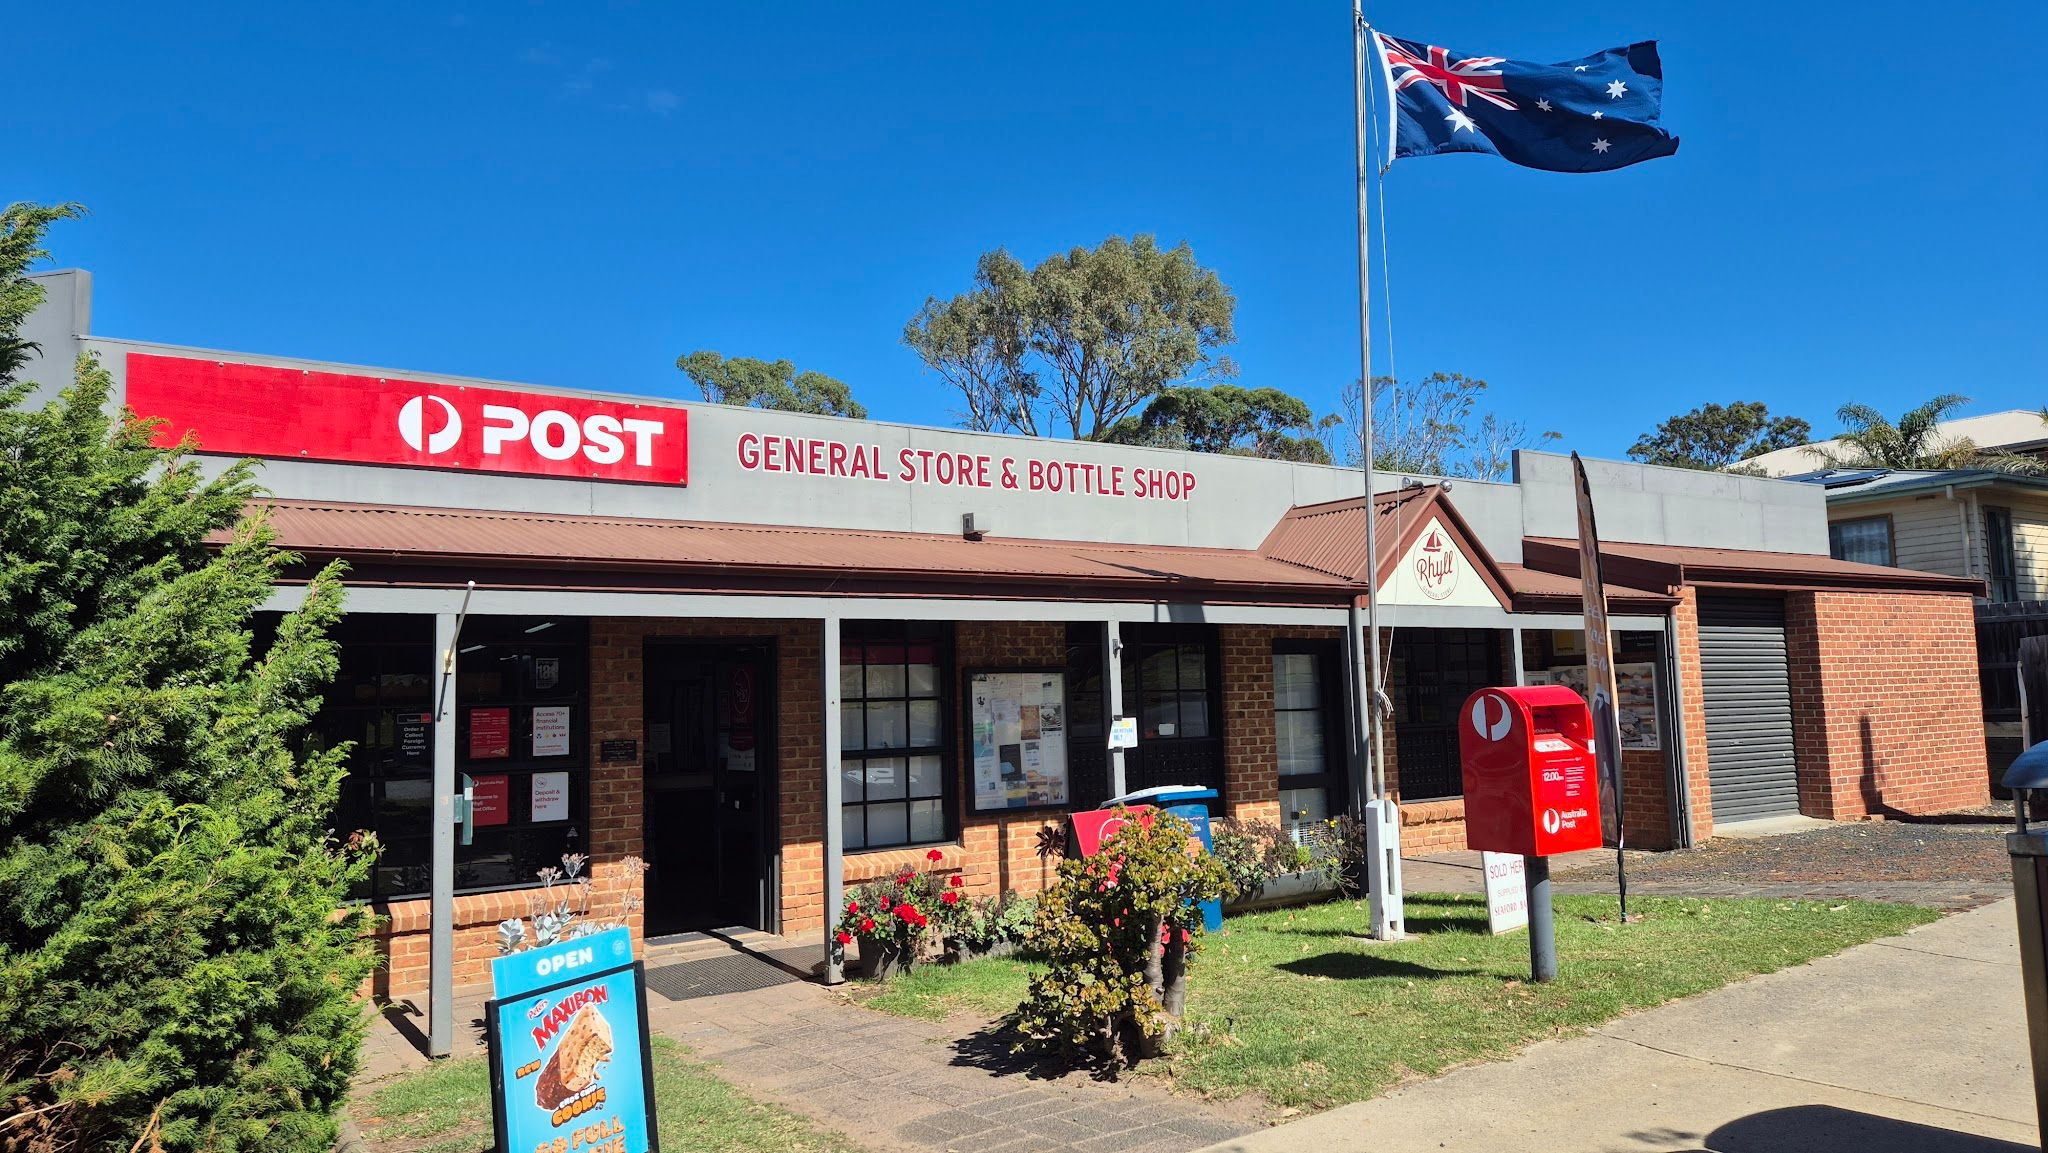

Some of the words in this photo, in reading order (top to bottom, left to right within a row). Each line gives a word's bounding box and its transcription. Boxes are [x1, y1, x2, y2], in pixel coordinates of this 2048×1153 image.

[483, 405, 664, 467] POST
[736, 431, 889, 482] GENERAL
[898, 447, 993, 488] STORE
[1000, 456, 1021, 491] &
[1028, 458, 1126, 497] BOTTLE
[1132, 467, 1198, 502] SHOP
[1416, 550, 1454, 588] Rhyll
[1561, 808, 1588, 819] Australia
[1561, 819, 1577, 829] Post
[1489, 863, 1508, 880] SOLD
[1510, 859, 1524, 875] HER
[535, 947, 594, 977] OPEN
[527, 1000, 549, 1020] Peters
[531, 984, 609, 1052] MAXIBON
[551, 1086, 607, 1128] COOKIE
[571, 1114, 625, 1150] FULL
